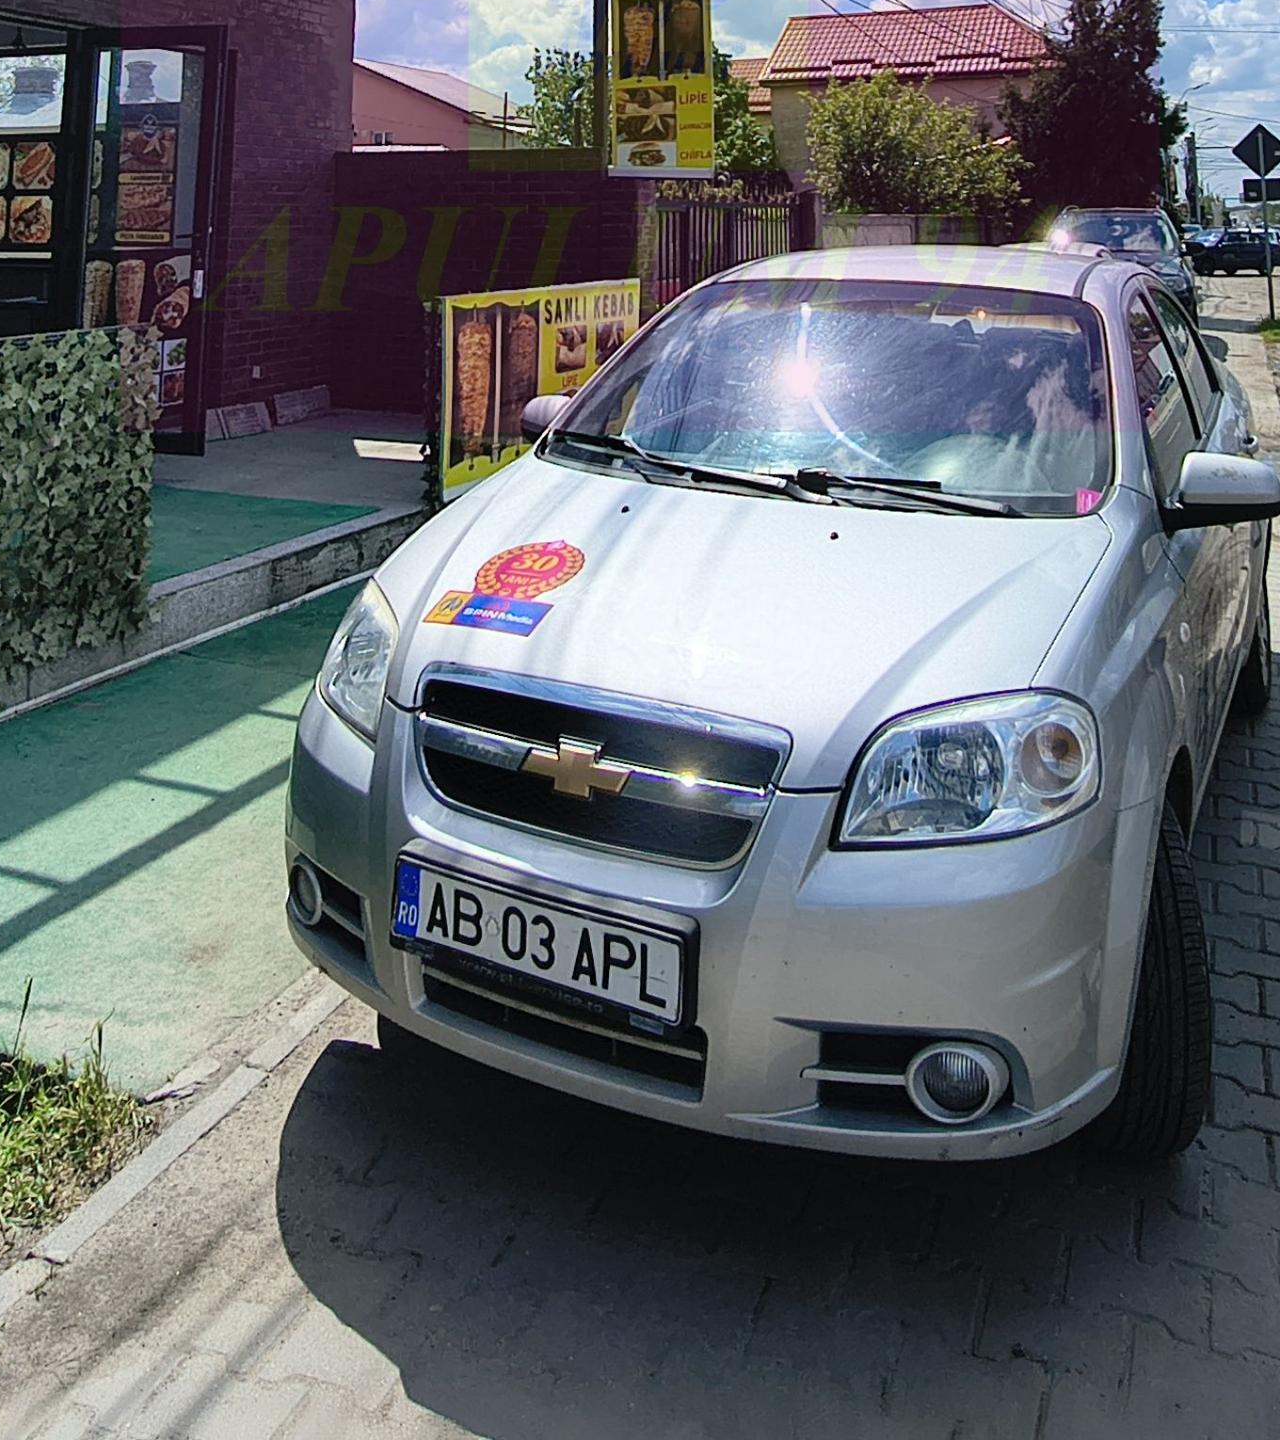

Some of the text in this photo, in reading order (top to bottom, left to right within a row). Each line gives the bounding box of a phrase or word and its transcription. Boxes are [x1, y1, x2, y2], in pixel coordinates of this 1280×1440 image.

[544, 292, 634, 325] SANLI KEBAB
[510, 552, 561, 572] 30
[398, 901, 418, 927] RO
[426, 882, 484, 947] AB
[501, 905, 556, 971] 03
[571, 926, 667, 1009] APL
